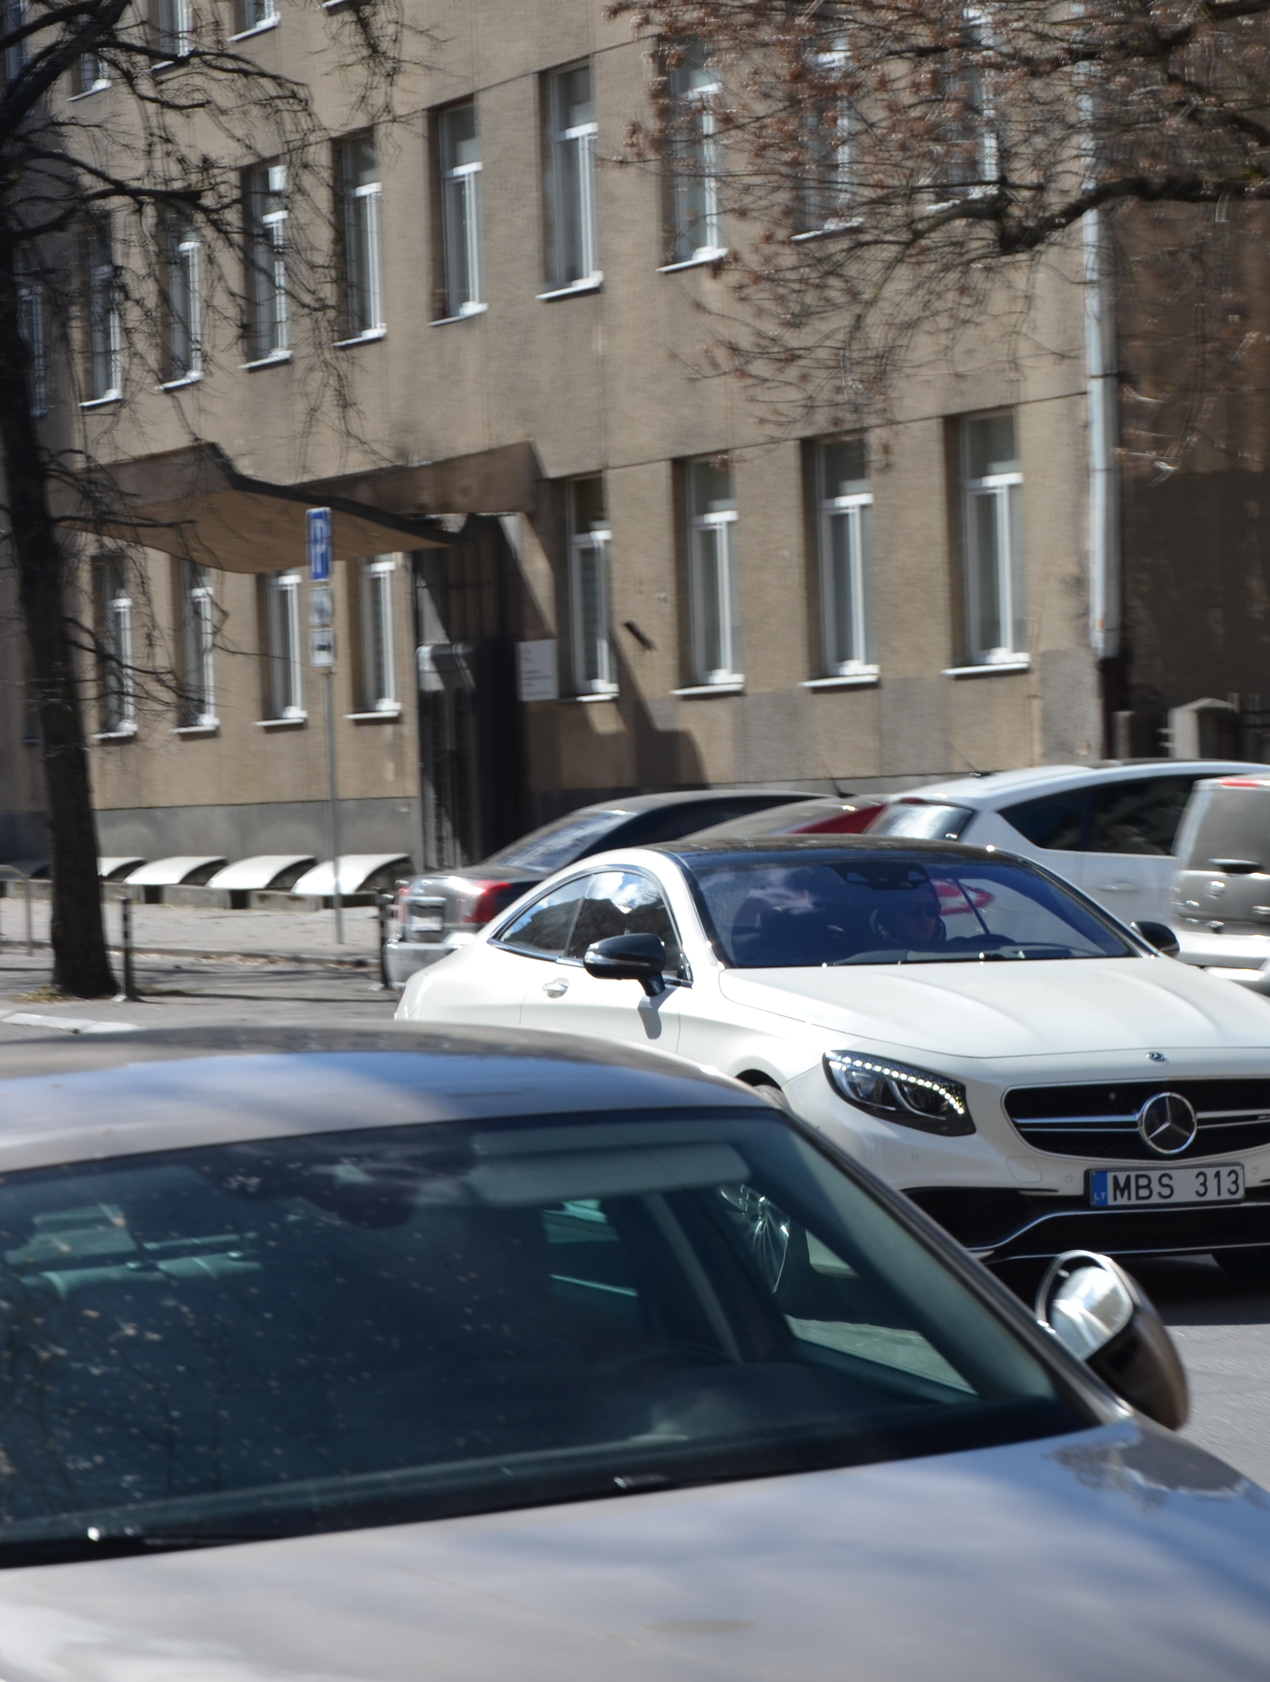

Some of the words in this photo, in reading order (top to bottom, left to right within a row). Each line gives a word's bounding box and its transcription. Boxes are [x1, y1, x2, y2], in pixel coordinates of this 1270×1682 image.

[1094, 1191, 1107, 1201] LT
[1112, 1173, 1174, 1202] MBS
[1194, 1169, 1240, 1198] 313
